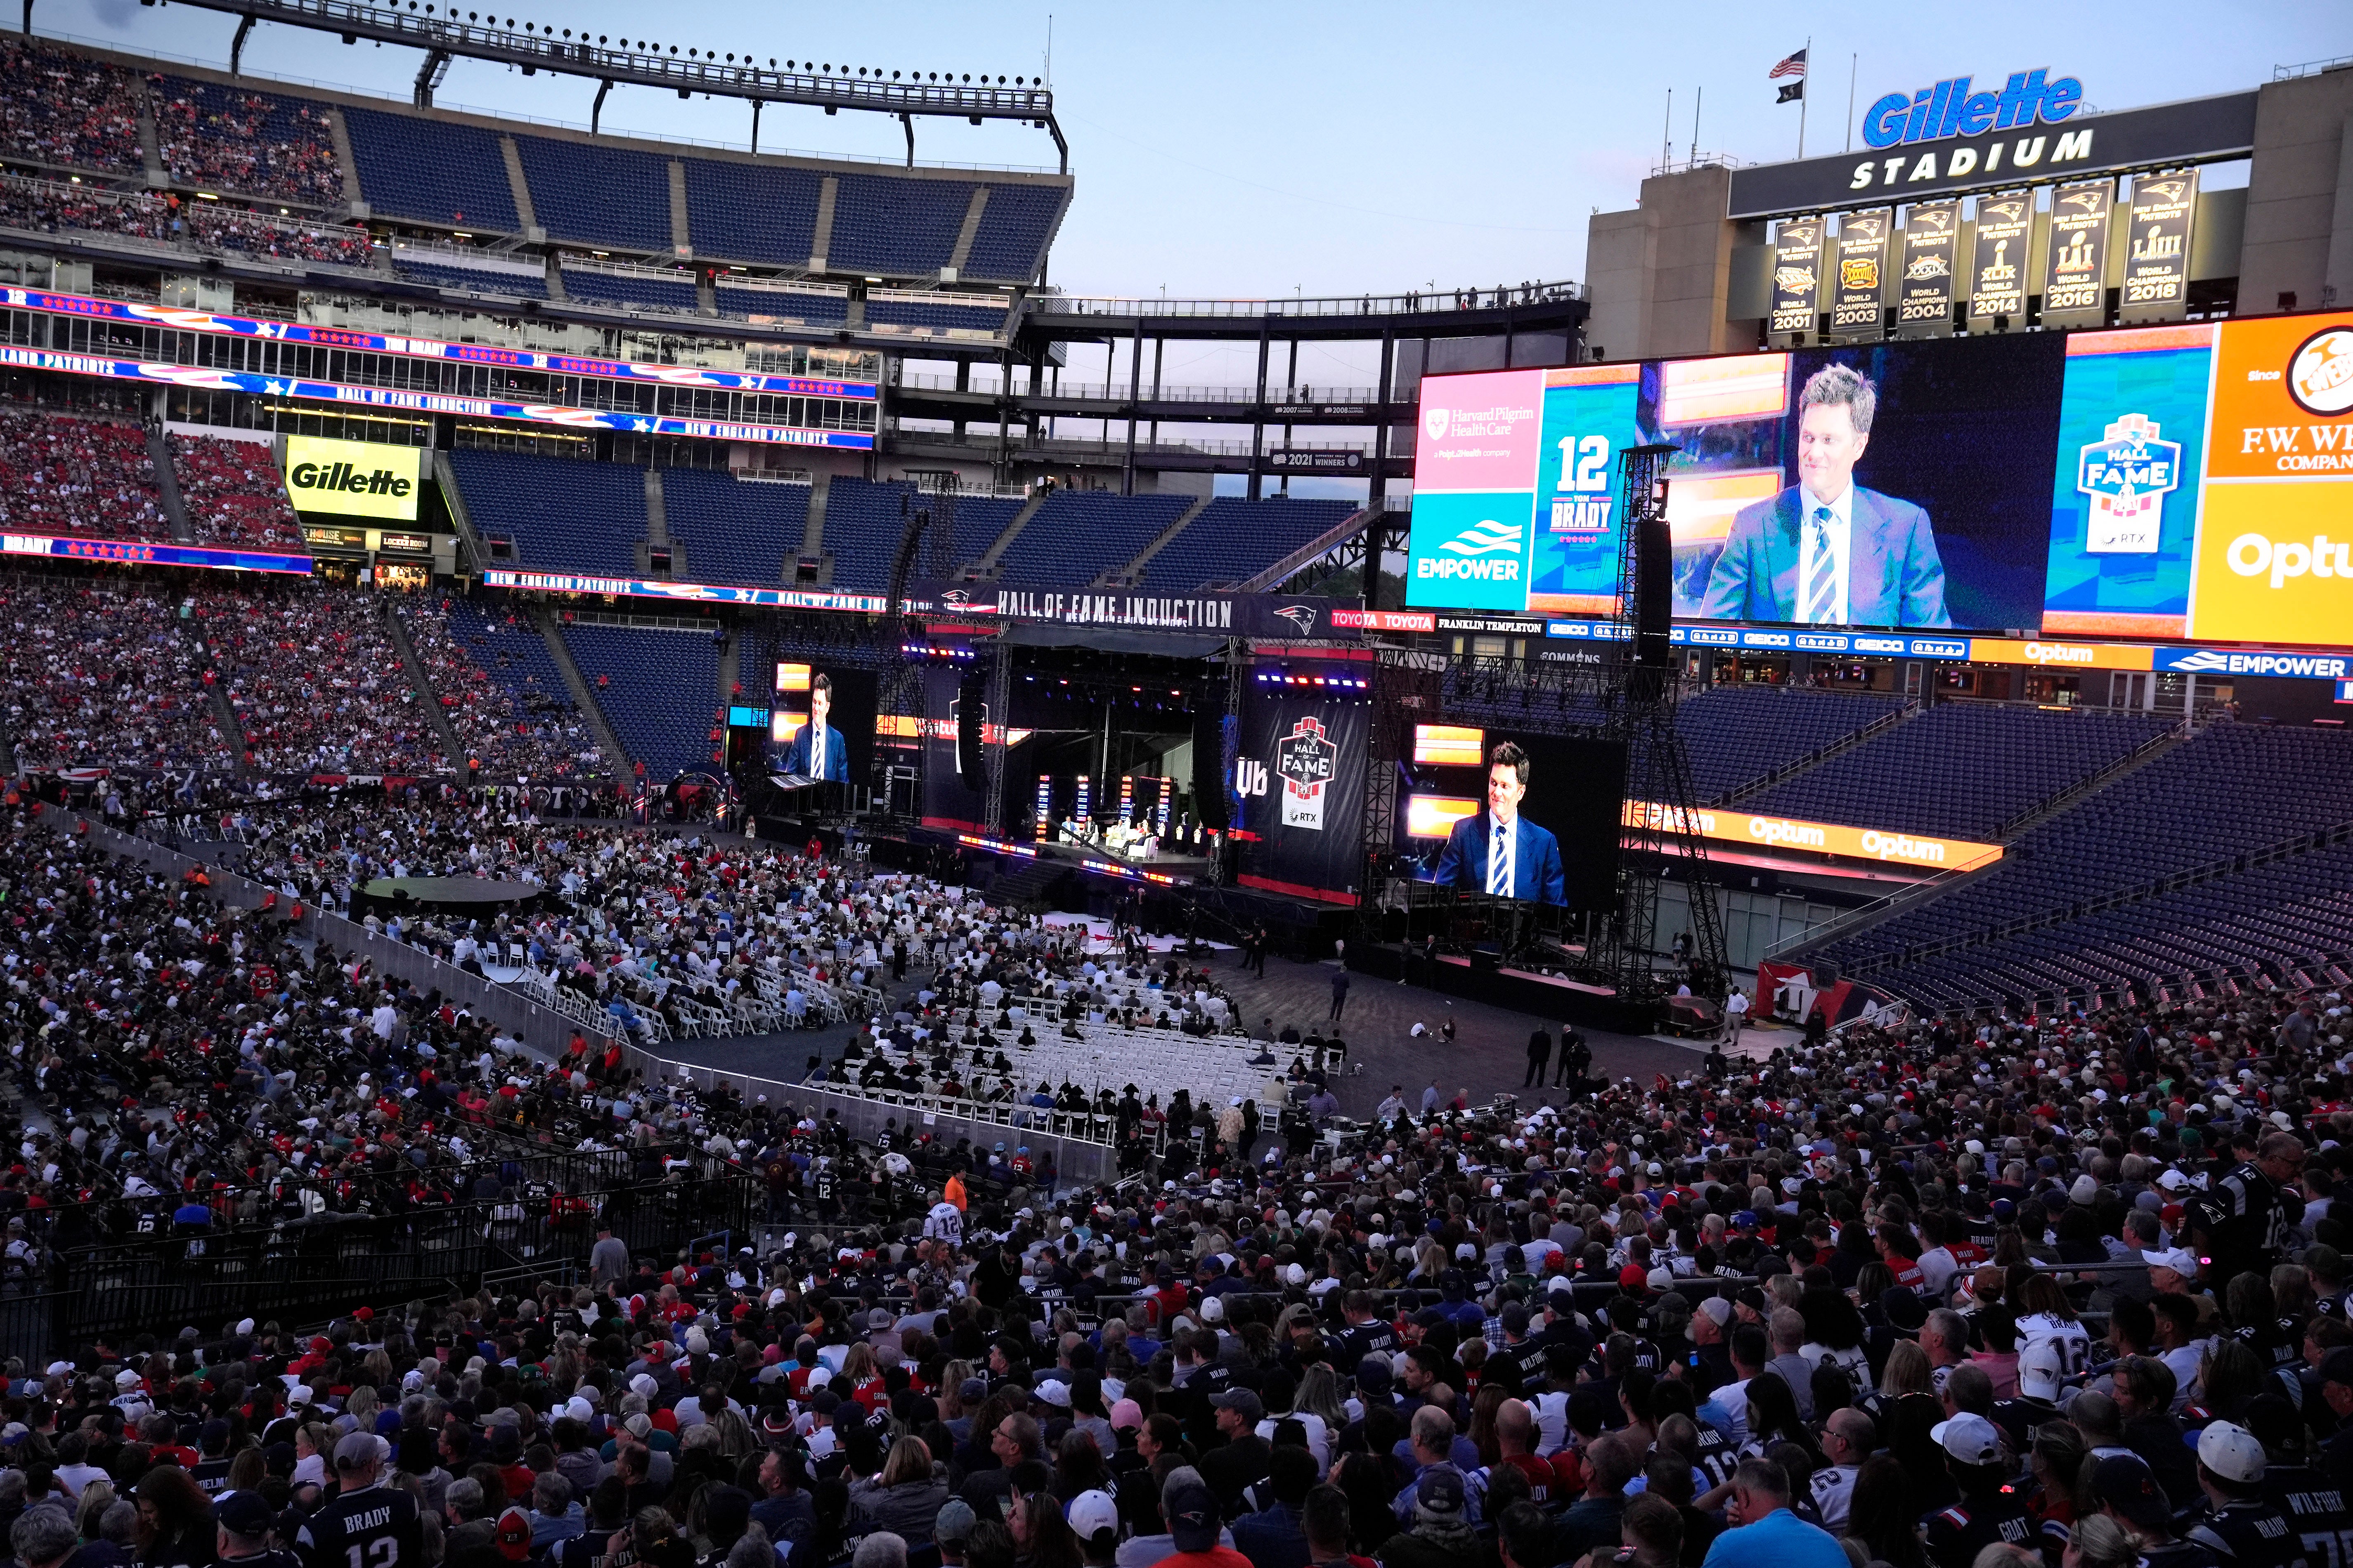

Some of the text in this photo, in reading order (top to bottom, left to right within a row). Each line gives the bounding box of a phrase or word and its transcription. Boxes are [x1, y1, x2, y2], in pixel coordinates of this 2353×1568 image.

[1863, 66, 2082, 149] Gillette
[1849, 128, 2094, 190] STADIUM
[2133, 201, 2189, 215] NEW ENGLAND
[2072, 211, 2105, 221] ENGLAND
[2138, 210, 2182, 222] PATRIOTS
[1995, 221, 2027, 230] ENGLAND
[2058, 220, 2099, 231] PATRIOTS
[1907, 229, 1953, 241] NEW ENGLAND
[1982, 229, 2021, 240] PATRIOTS
[1856, 237, 1884, 246] ENGLAND
[1911, 238, 1947, 248] PATRIOTS
[1791, 245, 1819, 253] ENGLAND
[1845, 245, 1878, 254] PATRIOTS
[1781, 252, 1813, 261] PATRIOTS
[1847, 267, 1873, 281] XXXVIII
[1910, 262, 1948, 275] XXXIX
[1981, 268, 2016, 282] XLIX
[2137, 265, 2172, 276] WORLD
[2057, 274, 2090, 284] WORLD
[2126, 274, 2182, 287] CHAMPIONS
[1911, 288, 1939, 297] WORLD
[1982, 281, 2013, 292] WORLD
[2047, 282, 2099, 295] CHAMPIONS
[2128, 283, 2177, 301] 2018
[7, 289, 26, 305] 12
[1844, 294, 1871, 303] WORLD
[1902, 296, 1947, 307] CHAMPIONS
[1972, 290, 2021, 301] CHAMPIONS
[2049, 291, 2095, 308] 2016
[1780, 300, 1806, 309] WORLD
[1836, 302, 1878, 312] CHAMPIONS
[1975, 298, 2017, 314] 2014
[1773, 308, 1813, 316] CHAMPIONS
[1835, 311, 1876, 325] 2003
[1901, 304, 1946, 319] 2004
[1774, 316, 1811, 329] 2001
[0, 349, 115, 375] LAND PATRIOTS
[532, 354, 547, 367] 12
[2248, 370, 2280, 381] Since
[2306, 352, 2353, 391] WEB
[337, 387, 491, 414] HALL OF FAME INDUCTION
[1452, 406, 1534, 424] Harvard Pilgrim
[685, 422, 828, 445] NEW ENGLAND PATRIOTS
[1451, 423, 1511, 437] Health Care
[2241, 427, 2301, 453] F.W.
[1289, 454, 1312, 465] 2021
[1483, 450, 1511, 458] company
[2107, 449, 2151, 461] HALL
[1556, 435, 1610, 491] 12
[2277, 454, 2353, 470] COMPAN
[292, 462, 410, 497] Gillette
[2087, 462, 2168, 486] FAME
[1551, 502, 1611, 528] BRADY
[3, 535, 53, 554] BRADY
[383, 538, 409, 546] LOCKER
[2121, 534, 2145, 544] RTX
[2227, 533, 2353, 588] Optu
[1417, 558, 1519, 581] EMPOWER
[490, 572, 631, 593] NEW ENGLAND PATRIOTS
[778, 592, 807, 606] HALL
[832, 596, 861, 609] FAME
[998, 590, 1232, 628] HALL OF FAME INDUCTION
[1333, 612, 1432, 629] TOYOTA TOYOTA
[1438, 619, 1542, 633] FRANKLIN TEMPLETON
[1550, 623, 1588, 635] GEICO
[1744, 634, 1789, 646] GEICO
[1855, 639, 1904, 652] GEICO
[2025, 642, 2093, 664] Optum
[2230, 655, 2345, 677] EMPOWER
[1295, 744, 1320, 754] HALL
[1282, 754, 1329, 776] FAME
[1300, 812, 1317, 822] RTX
[1750, 816, 1944, 861] Optum Optum
[819, 1184, 830, 1199] 12
[914, 1183, 926, 1194] 12
[137, 1221, 154, 1232] 12
[941, 1215, 959, 1235] 12
[1971, 1236, 1994, 1245] BRADY
[1957, 1249, 1974, 1259] BRADY
[1714, 1264, 1742, 1279] BRADY
[1473, 1280, 1491, 1292] BRADY
[1041, 1288, 1063, 1298] BRADY
[2050, 1320, 2080, 1331] BRADY
[1369, 1334, 1392, 1350] BRADY
[2048, 1337, 2093, 1377] 12
[2272, 1344, 2294, 1363] BRADY
[1209, 1367, 1229, 1379] BRADY
[2285, 1490, 2347, 1516] WILFORK
[343, 1506, 390, 1534] BRADY
[1998, 1516, 2030, 1543] GOAT
[2252, 1516, 2289, 1539] BRADY
